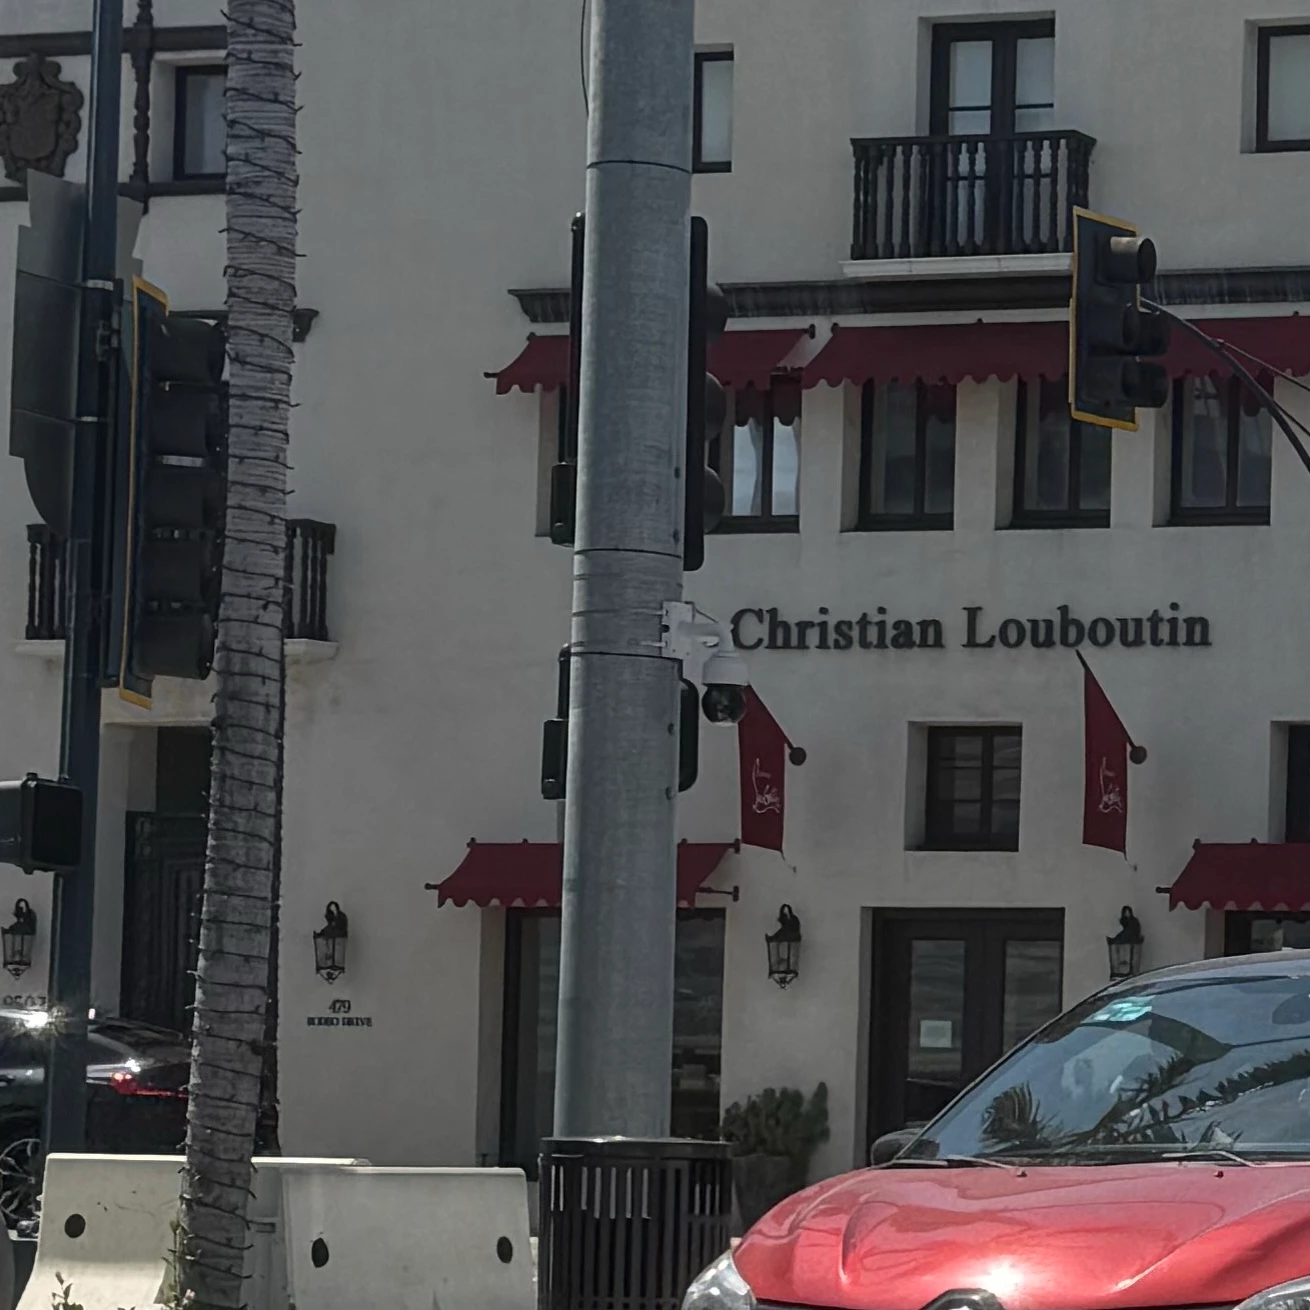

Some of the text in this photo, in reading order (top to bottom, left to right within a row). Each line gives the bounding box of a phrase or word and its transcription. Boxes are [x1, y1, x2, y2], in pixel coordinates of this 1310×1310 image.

[730, 602, 1213, 650] Christian Louboutin
[328, 998, 351, 1014] 479
